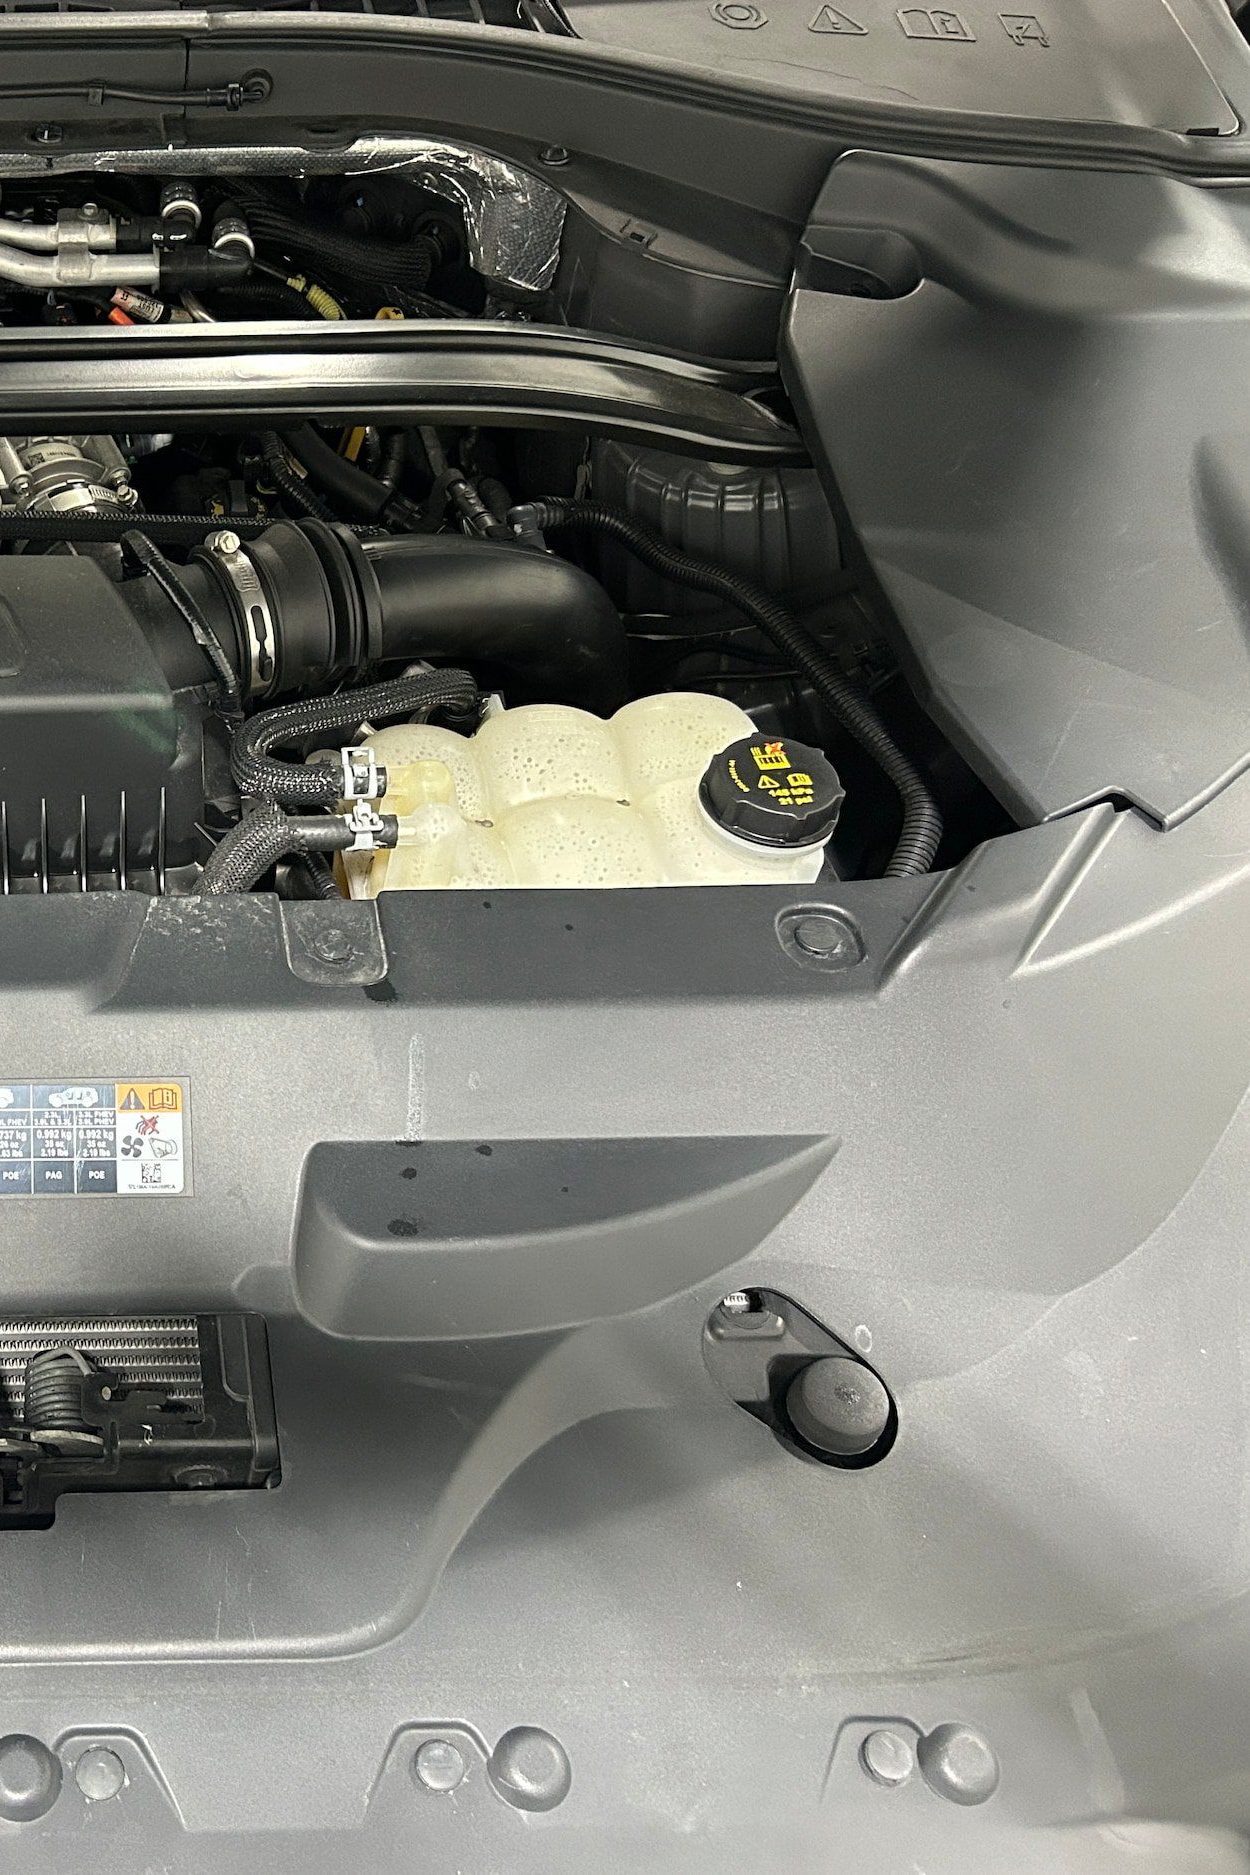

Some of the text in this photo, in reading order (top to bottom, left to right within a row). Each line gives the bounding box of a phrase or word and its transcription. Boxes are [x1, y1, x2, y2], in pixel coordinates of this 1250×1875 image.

[15, 1130, 27, 1142] kg
[61, 1129, 72, 1141] kg
[103, 1129, 114, 1141] kg
[2, 1171, 19, 1180] POE
[45, 1170, 63, 1180] PAG
[88, 1170, 106, 1180] POE
